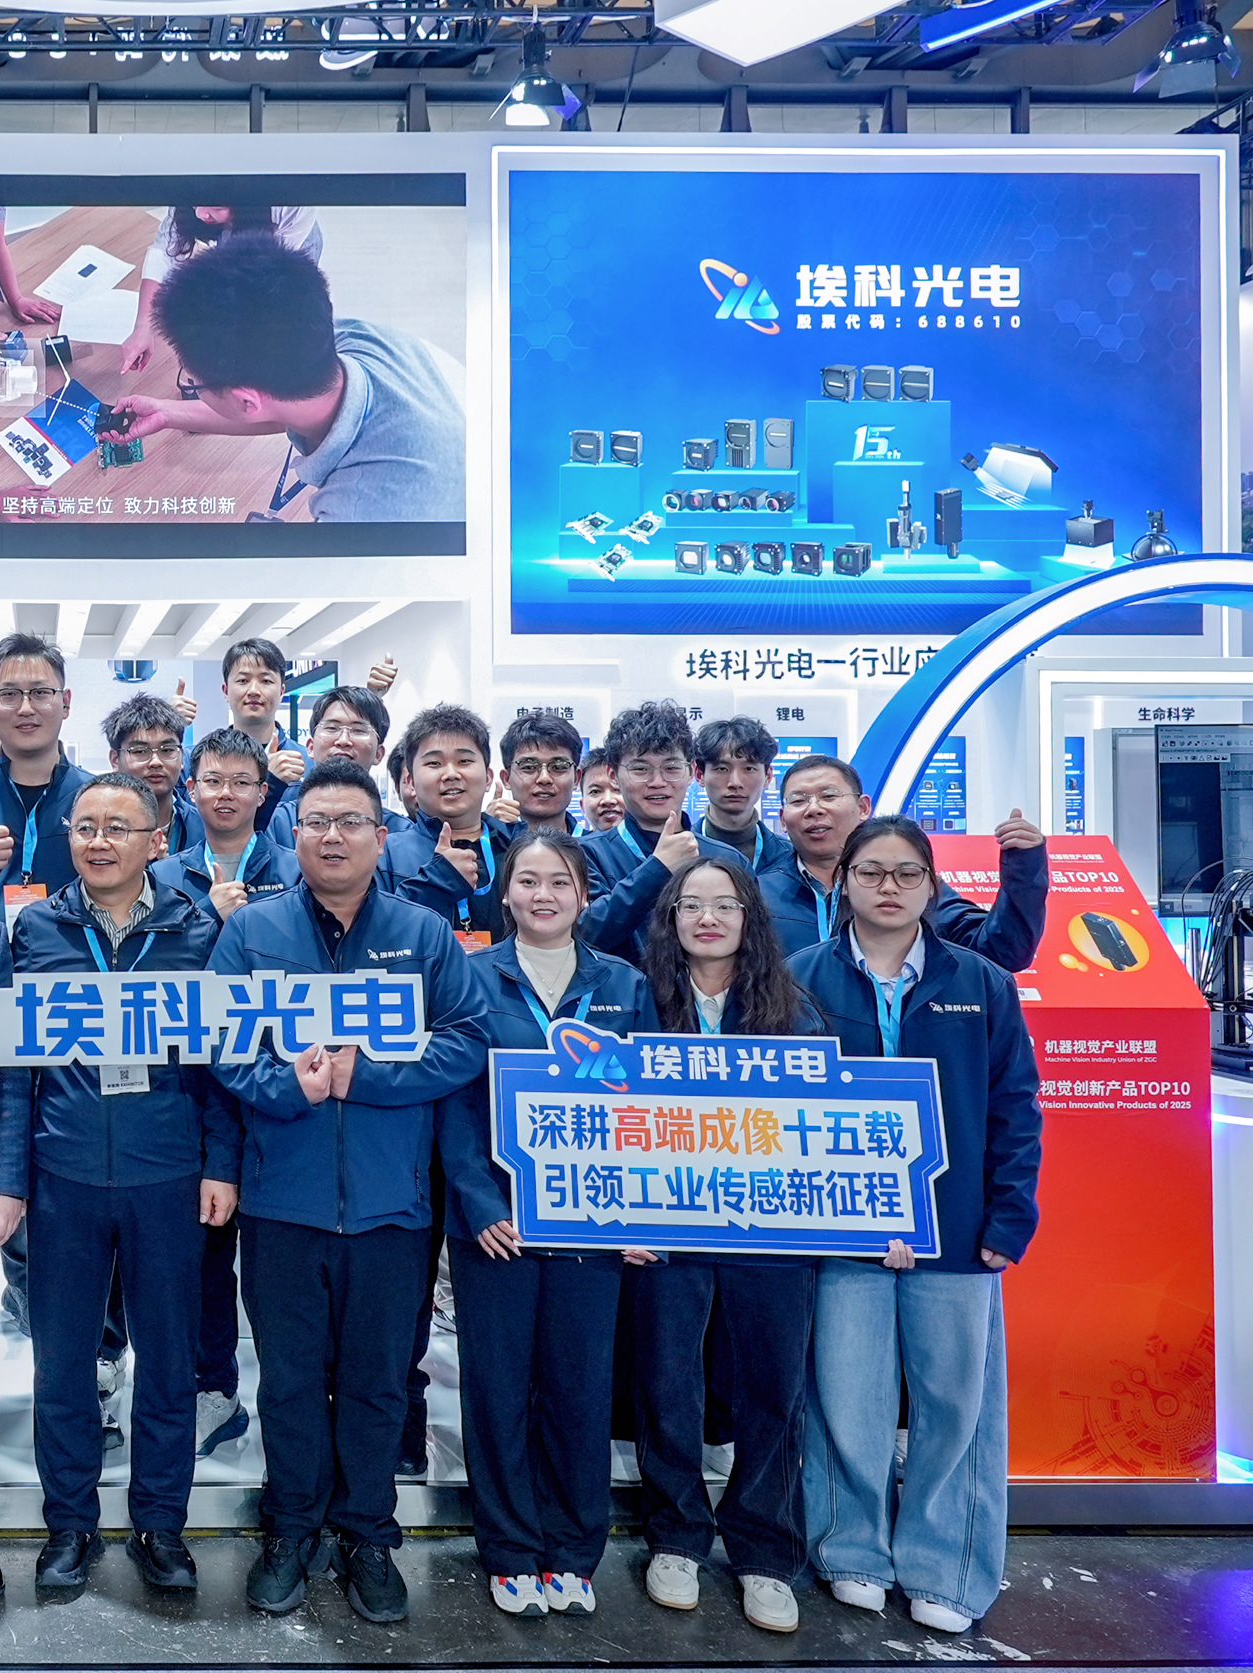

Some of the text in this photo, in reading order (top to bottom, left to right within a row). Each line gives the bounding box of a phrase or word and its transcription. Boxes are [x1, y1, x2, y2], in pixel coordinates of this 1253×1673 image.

[796, 264, 1020, 307] 埃科光电
[2, 497, 236, 514] 坚持高端定位 致力科技创新
[776, 707, 805, 721] 锂电
[1138, 707, 1195, 721] 生命科学
[15, 978, 419, 1056] 埃科光电
[1045, 1039, 1157, 1054] 机器视觉产业联盟
[640, 1044, 828, 1083] 埃科光电
[1091, 1056, 1117, 1064] Industry
[1036, 1080, 1191, 1096] 视觉创新产品TOP10
[1039, 1100, 1191, 1110] Vision Innovative Products of 2025
[527, 1102, 907, 1159] 深耕高端成像十五载
[545, 1163, 905, 1218] 引领工业传感新征程
